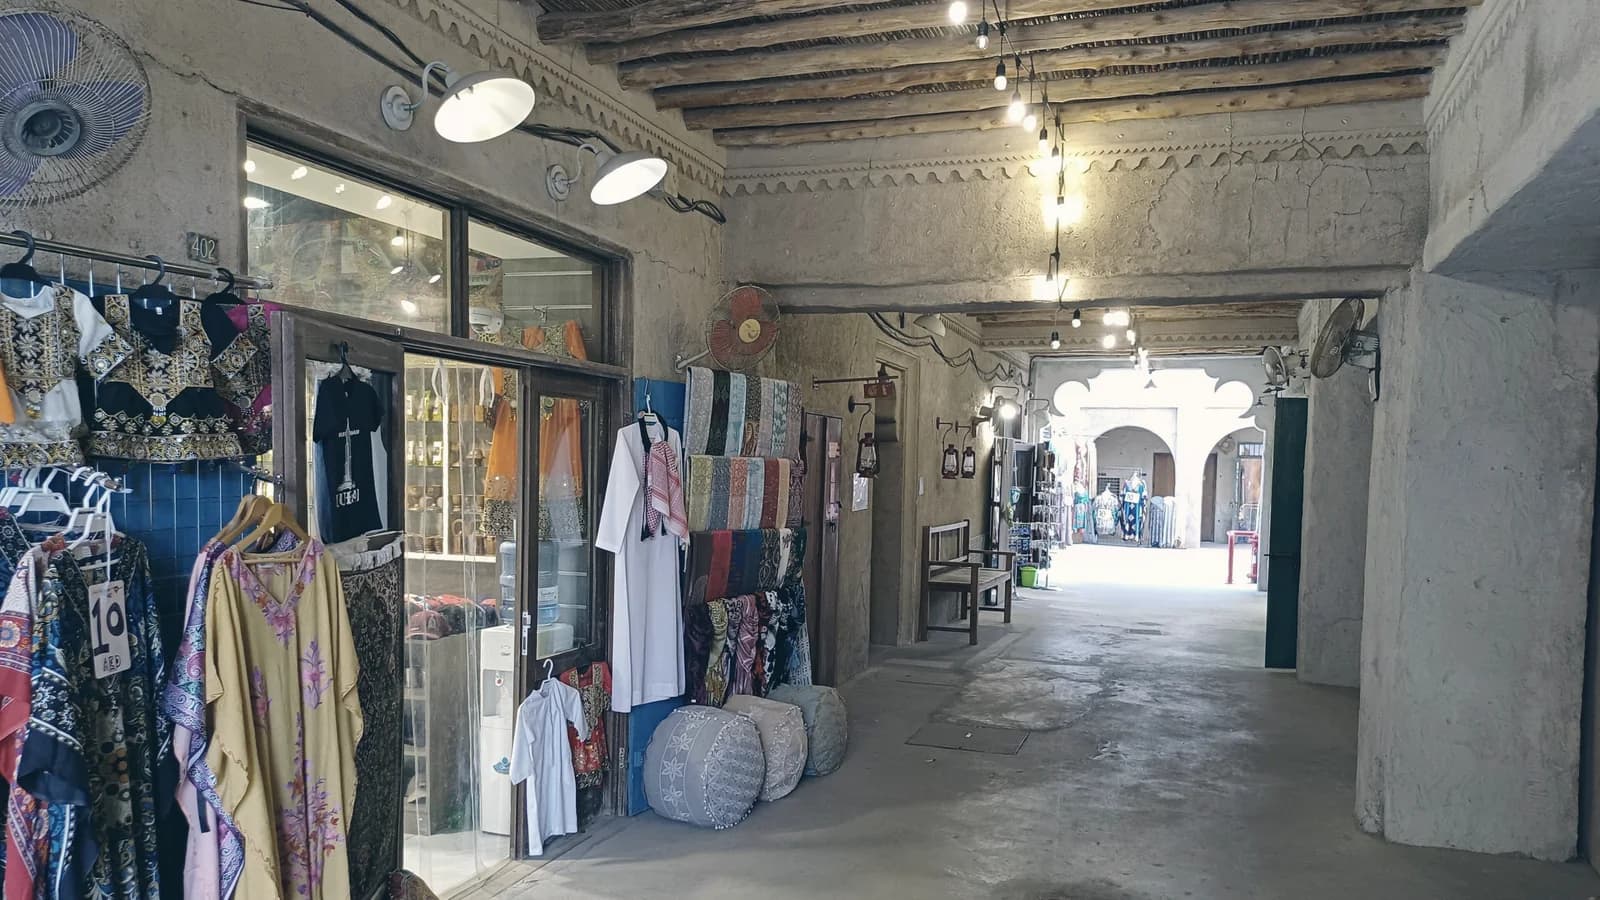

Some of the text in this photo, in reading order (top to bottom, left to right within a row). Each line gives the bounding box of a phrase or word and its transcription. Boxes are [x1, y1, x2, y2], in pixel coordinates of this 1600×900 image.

[191, 235, 216, 260] 402
[92, 597, 125, 656] 10
[103, 655, 122, 672] AED
